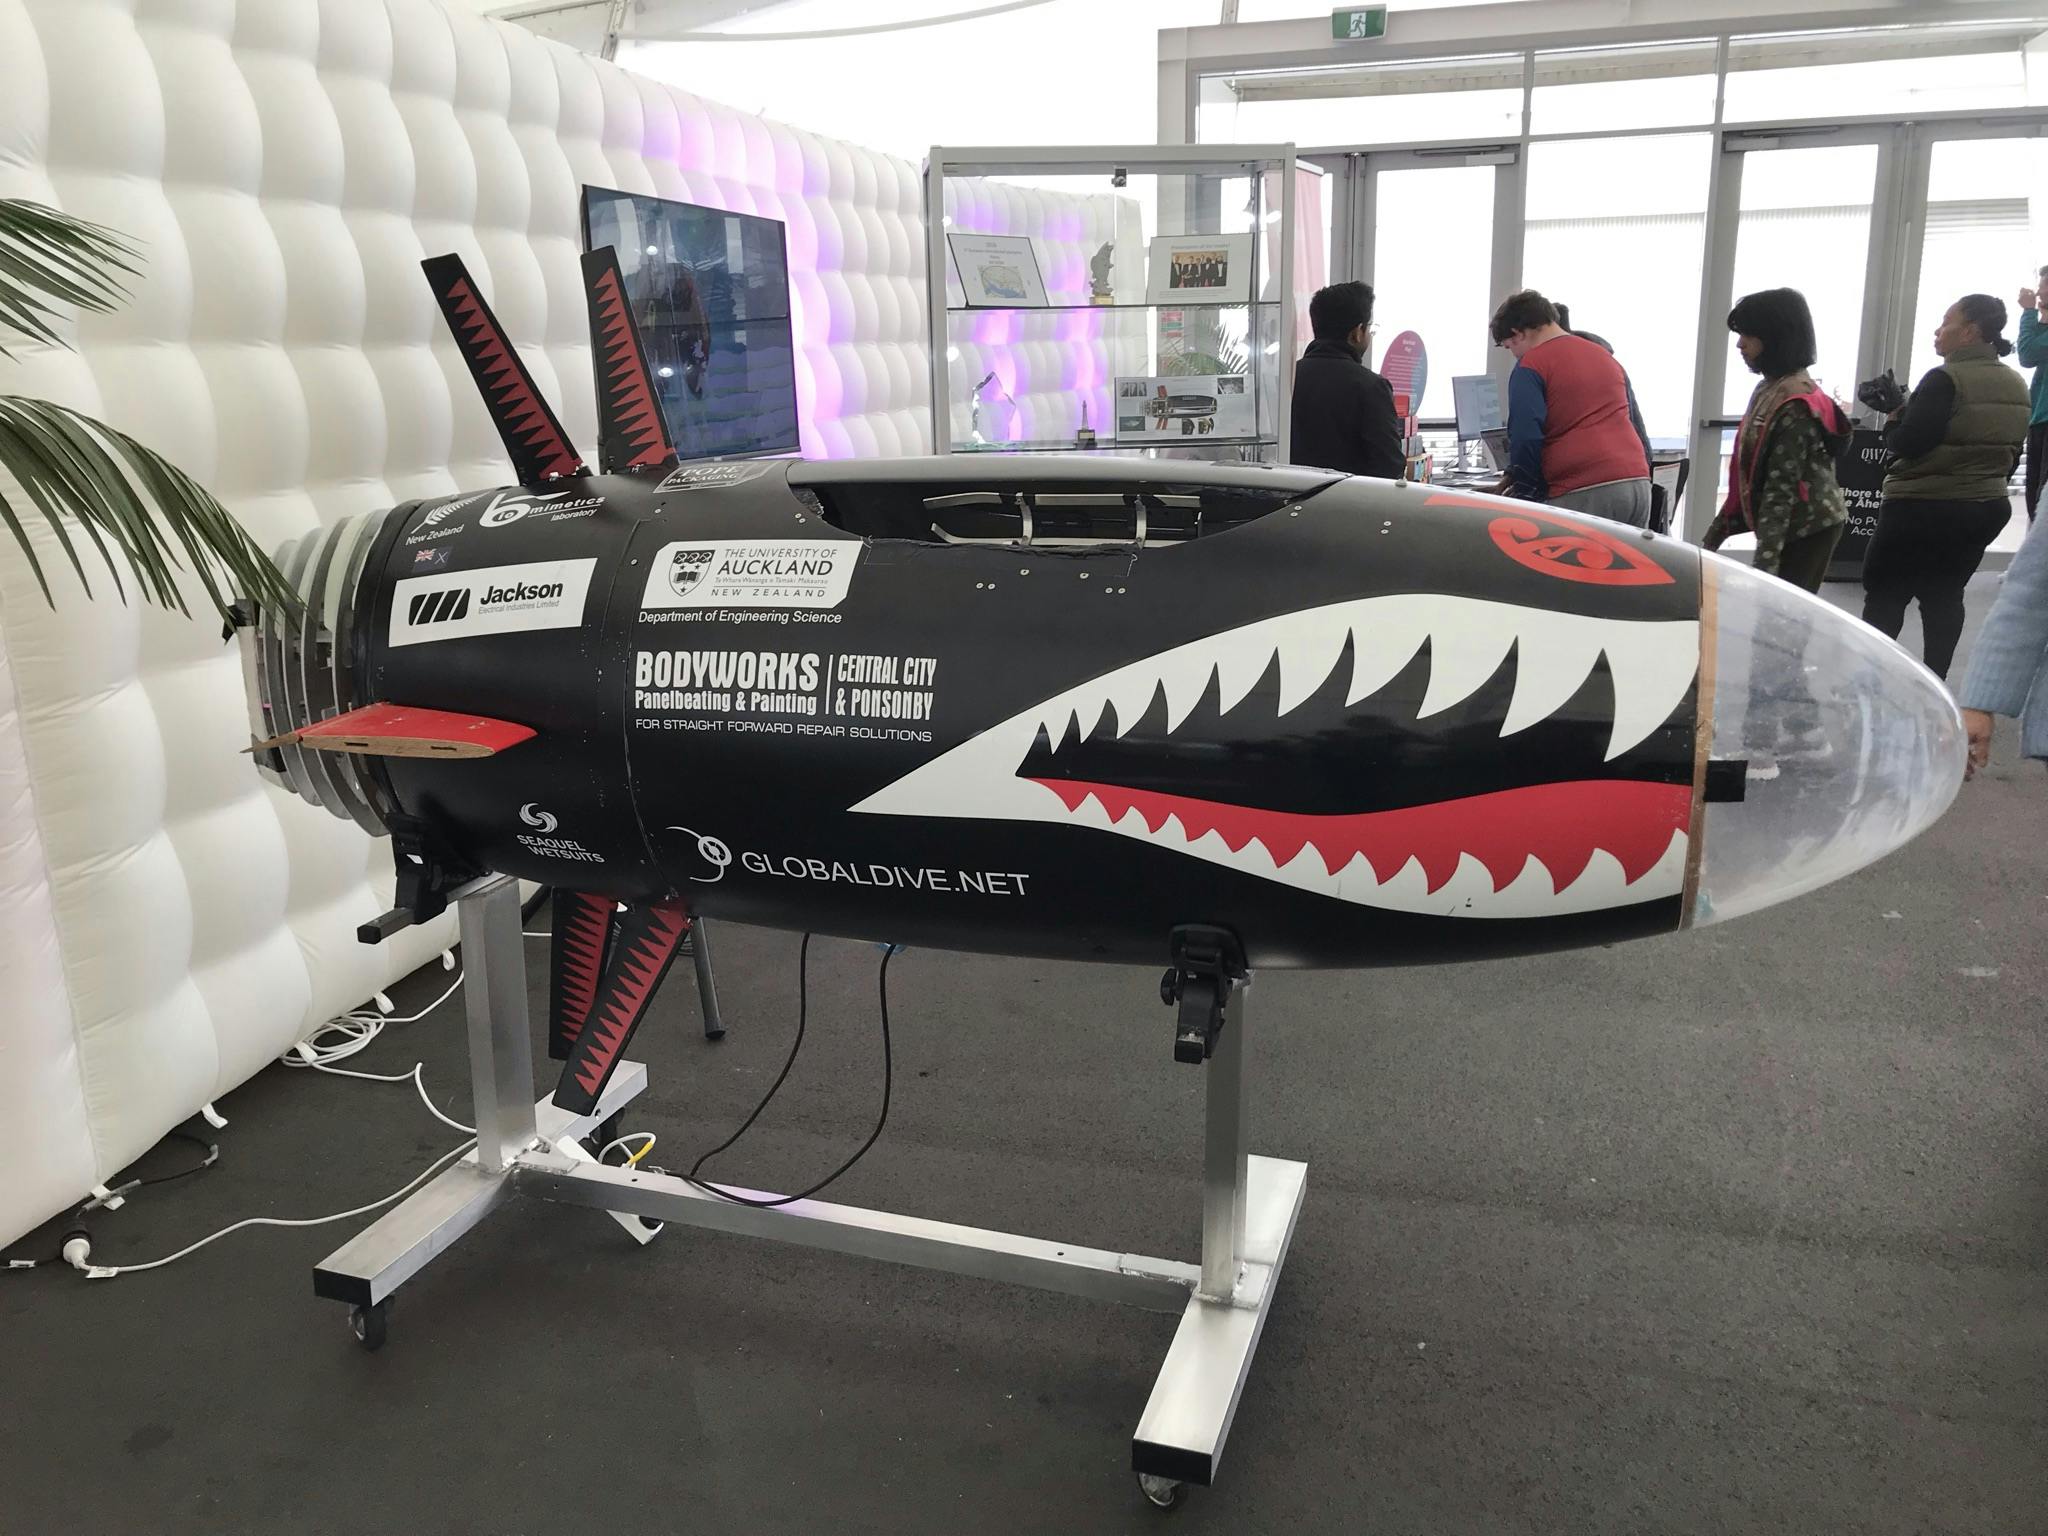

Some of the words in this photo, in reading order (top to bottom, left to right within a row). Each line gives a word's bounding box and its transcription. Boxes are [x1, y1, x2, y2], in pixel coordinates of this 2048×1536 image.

[666, 473, 738, 484] PACKAGING
[550, 507, 598, 522] laboratory
[1845, 515, 1863, 525] No
[405, 533, 427, 546] New
[426, 524, 465, 541] Zealand
[1851, 526, 1874, 536] Acc
[725, 548, 745, 558] THE
[749, 548, 821, 558] UNIVERSITY
[820, 549, 838, 558] OF
[717, 560, 833, 576] AUCKLAND
[480, 582, 564, 605] Jackson
[711, 588, 742, 597] NEW
[752, 588, 826, 598] ZEALAND
[478, 604, 505, 615] Electrical
[505, 602, 535, 613] Industries
[536, 599, 560, 610] Limited
[638, 610, 702, 625] Department
[704, 609, 718, 622] of
[719, 610, 789, 625] Engineering
[792, 610, 842, 624] Science
[635, 650, 820, 692] BODYWORKS
[837, 654, 899, 685] CENTRAL
[903, 657, 937, 687] CITY
[635, 690, 731, 713] Panelbeating
[735, 691, 746, 712] &
[750, 691, 817, 716] Painting
[835, 687, 846, 716] &
[851, 688, 934, 721] PONSONBY
[635, 718, 660, 729] FOR
[663, 719, 723, 732] STRAIGHT
[727, 721, 793, 734] FORWARD
[797, 724, 845, 737] REPAIR
[849, 726, 932, 742] SOLUTIONS
[516, 834, 587, 852] SEAQUEL
[527, 845, 605, 863] WETSUITS
[741, 851, 1030, 897] GLOBALDIVE.NET
